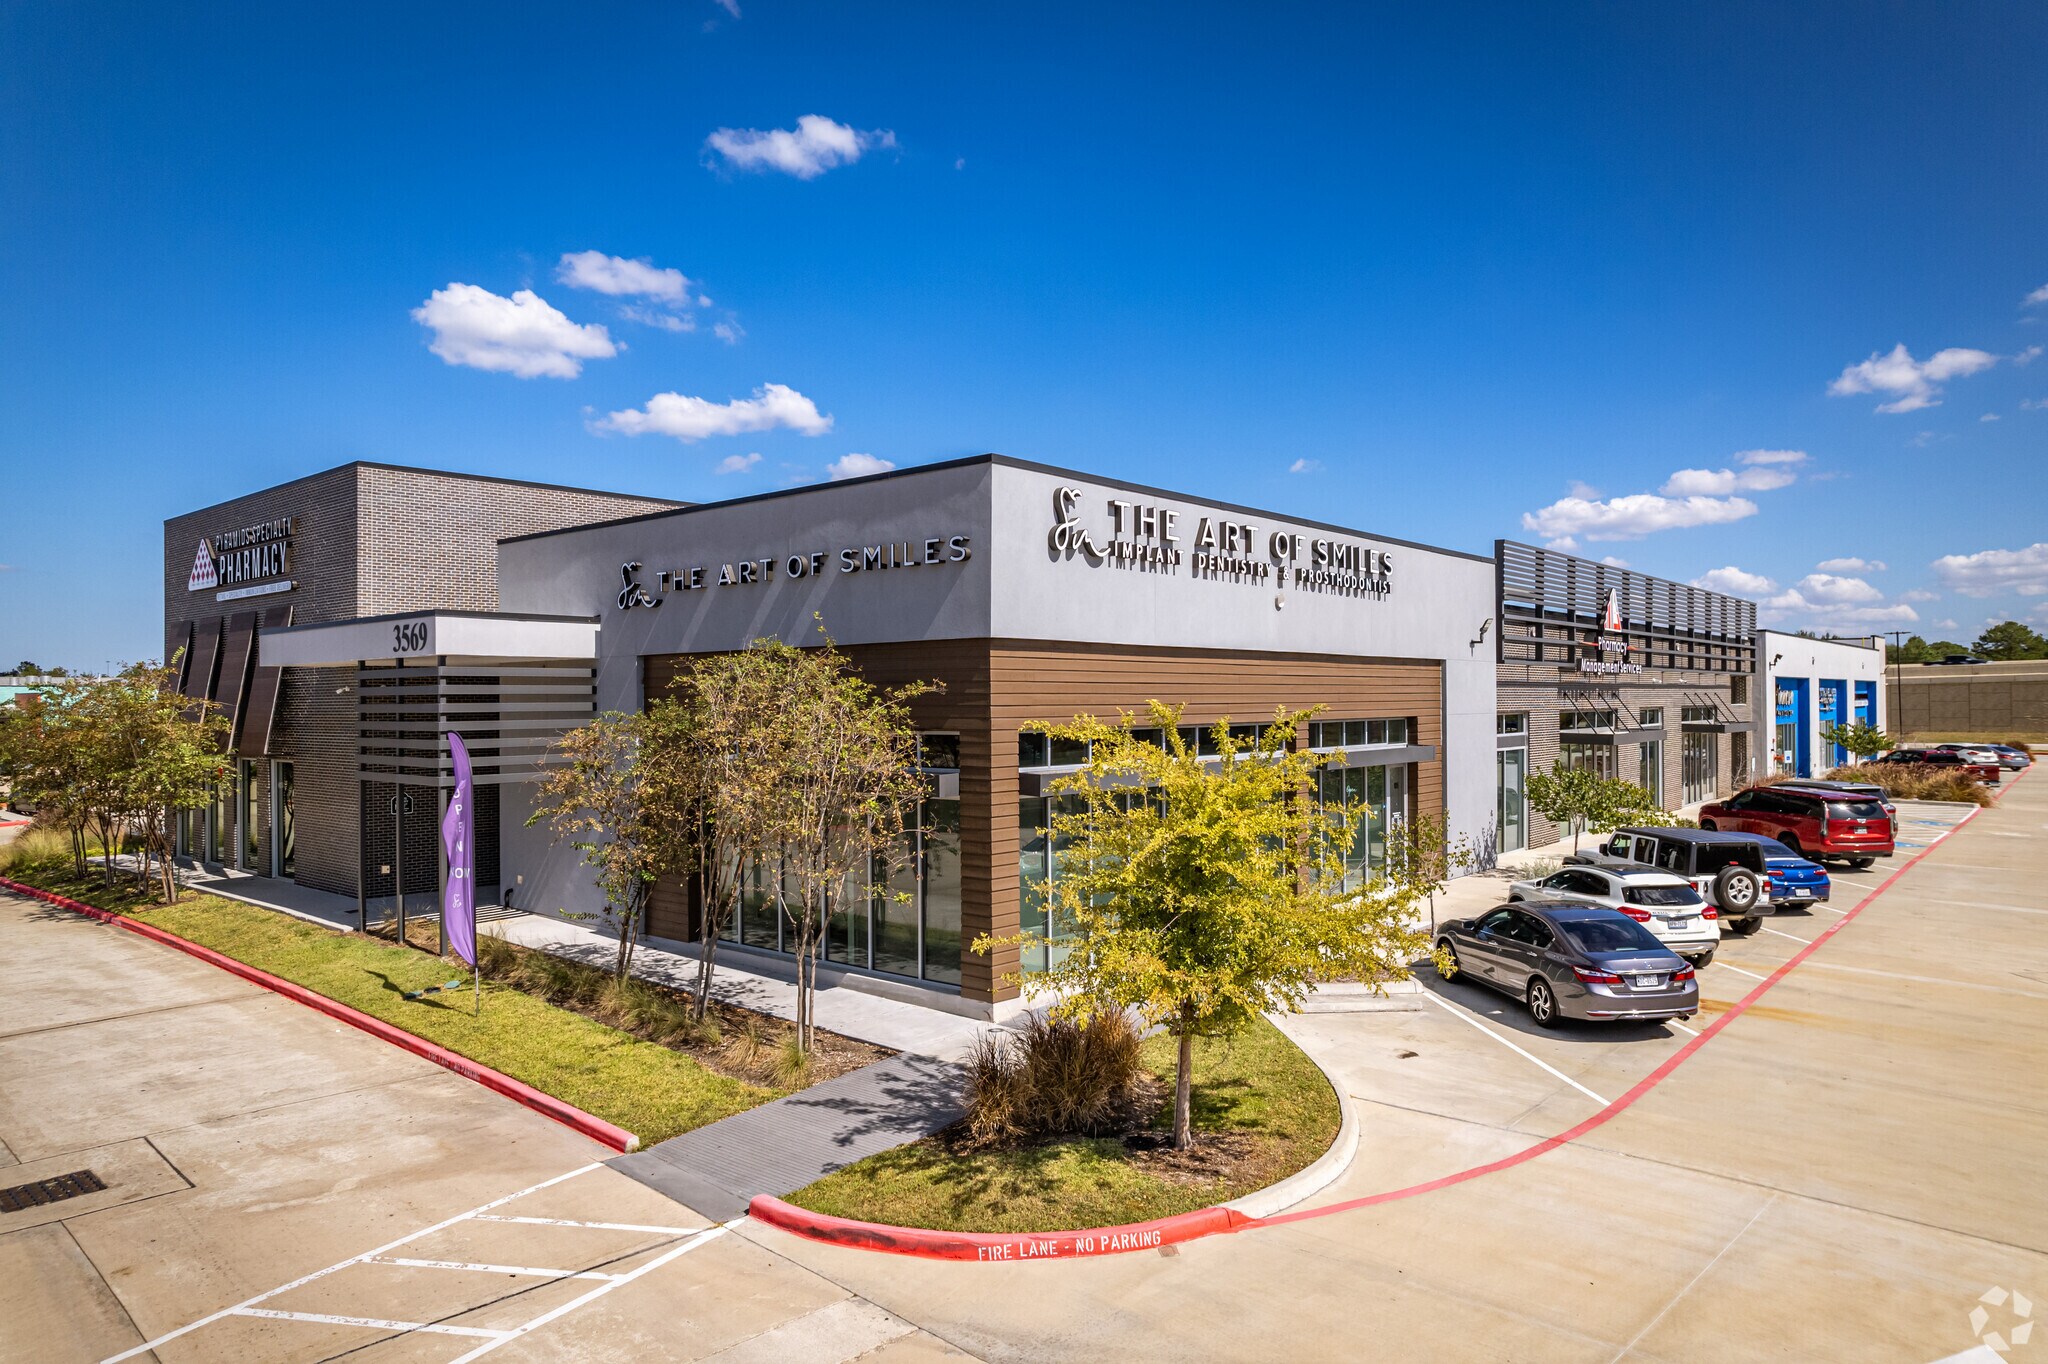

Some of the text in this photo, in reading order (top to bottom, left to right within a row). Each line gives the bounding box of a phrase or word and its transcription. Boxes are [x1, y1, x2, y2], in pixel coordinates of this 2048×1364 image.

[215, 516, 292, 552] PYRAMIDS SPECIALTY
[1112, 500, 1180, 542] THE
[1199, 517, 1259, 554] ART
[1273, 531, 1307, 561] OF
[1315, 539, 1394, 576] SMILES
[219, 541, 287, 585] PHARMACY
[656, 567, 703, 593] THE
[717, 557, 774, 586] ART
[786, 552, 825, 579] OF
[840, 536, 968, 573] SMILES
[1114, 540, 1184, 565] IMPLANT
[1197, 552, 1272, 577] DENTISTRY
[392, 622, 428, 653] 3569
[1598, 636, 1627, 655] Pharmacy
[1580, 658, 1642, 675] Management Services
[978, 1243, 1012, 1261] FIRE
[1019, 1240, 1058, 1257] LANE
[1076, 1237, 1094, 1253] NO
[1101, 1230, 1161, 1251] PARKING
